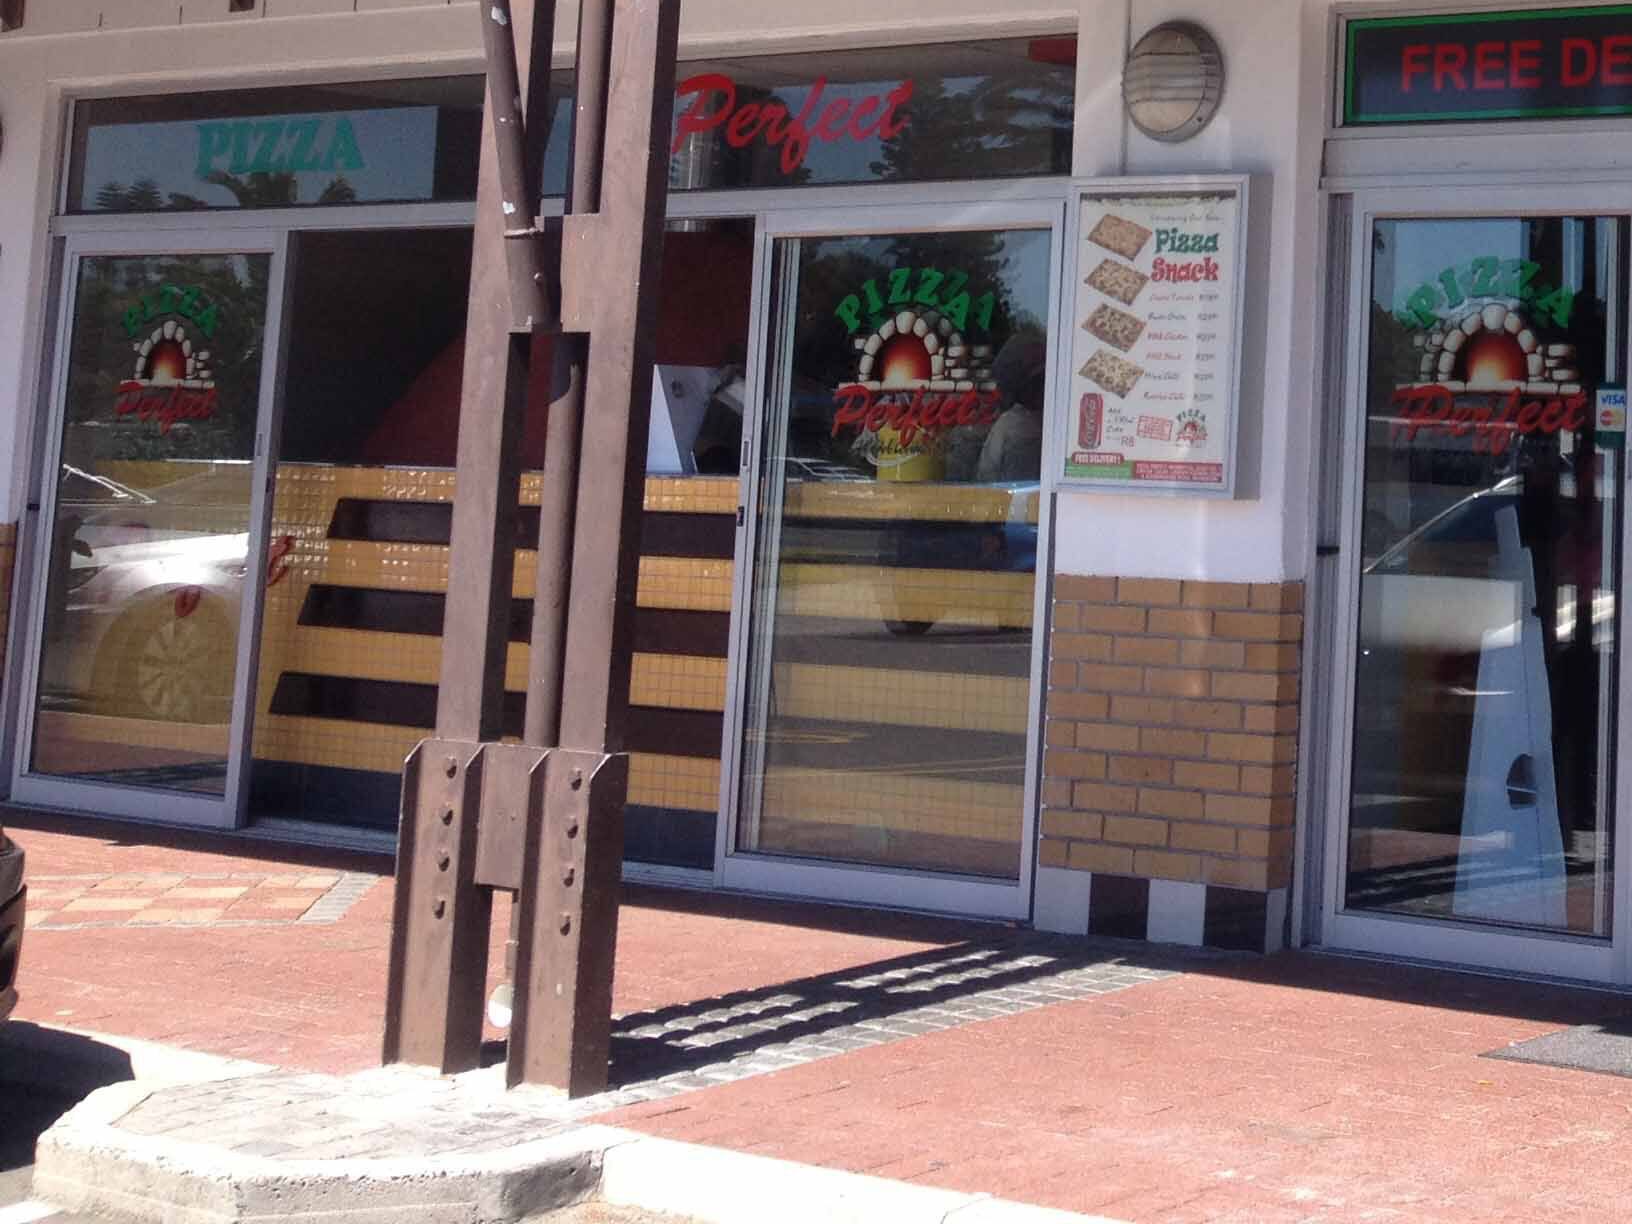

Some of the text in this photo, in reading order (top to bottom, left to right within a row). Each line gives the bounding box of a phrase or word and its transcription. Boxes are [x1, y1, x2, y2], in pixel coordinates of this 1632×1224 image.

[1400, 39, 1542, 93] FREE
[194, 117, 365, 177] PIZZA
[672, 72, 914, 175] Perfect
[1154, 227, 1219, 253] Pizza
[1151, 256, 1219, 283] Snack
[1404, 254, 1576, 329] PIZZA
[122, 283, 218, 337] PIZZA
[114, 381, 218, 435] Perfect
[1391, 383, 1587, 455] Perfect
[1600, 394, 1626, 405] VISA
